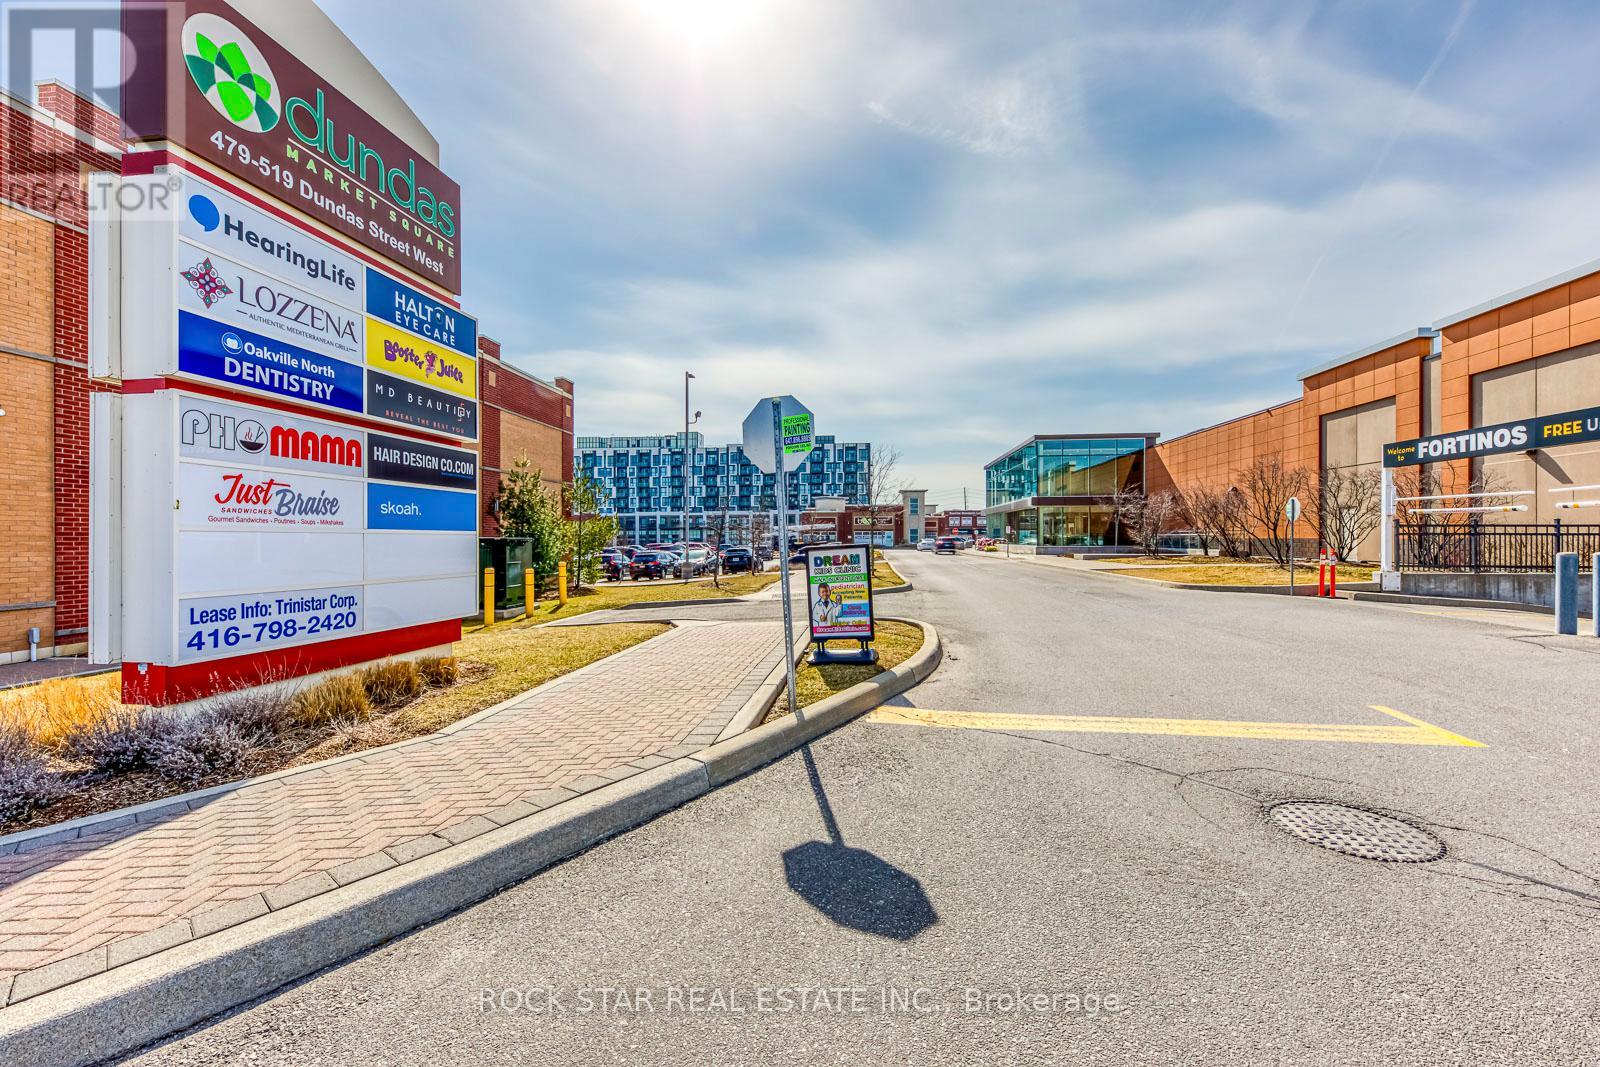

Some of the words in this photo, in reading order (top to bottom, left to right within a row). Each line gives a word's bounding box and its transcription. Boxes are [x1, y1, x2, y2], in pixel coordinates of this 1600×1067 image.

[285, 88, 455, 238] dundas
[209, 130, 294, 190] 479-519
[299, 178, 365, 230] Dundas
[368, 221, 410, 257] Street
[412, 248, 444, 276] West
[286, 144, 378, 210] MARKET
[389, 210, 455, 258] SQUARE
[224, 213, 356, 291] HearingLife
[249, 313, 286, 331] AUTHENTIC
[395, 310, 419, 331] EYE
[423, 323, 456, 346] CARE
[244, 342, 299, 369] Oakville
[301, 358, 336, 379] North
[383, 339, 424, 370] Booster
[436, 358, 464, 384] Juice
[224, 357, 335, 401] DENTISTRY
[375, 383, 395, 398] MD
[270, 426, 362, 467] MAMA
[784, 423, 810, 436] PAINTING
[1418, 425, 1528, 459] FORTINOS
[1543, 420, 1582, 438] FREE
[373, 446, 400, 464] HAIR
[402, 451, 438, 470] DESIGN
[440, 458, 474, 475] CO.COM
[1387, 446, 1415, 455] Welcome
[1397, 454, 1405, 462] to
[214, 473, 291, 506] Just
[274, 489, 340, 517] Braise
[220, 507, 273, 515] SANDWICHES
[380, 501, 422, 516] skoah.
[208, 515, 235, 523] Gourmet
[235, 516, 269, 524] Sandwiches
[813, 554, 860, 567] DREAM
[190, 606, 238, 625] Lease
[241, 602, 272, 619] Info:
[275, 598, 327, 615] Trinistar
[330, 594, 358, 612] Corp.
[186, 611, 357, 651] 416-798-2420
